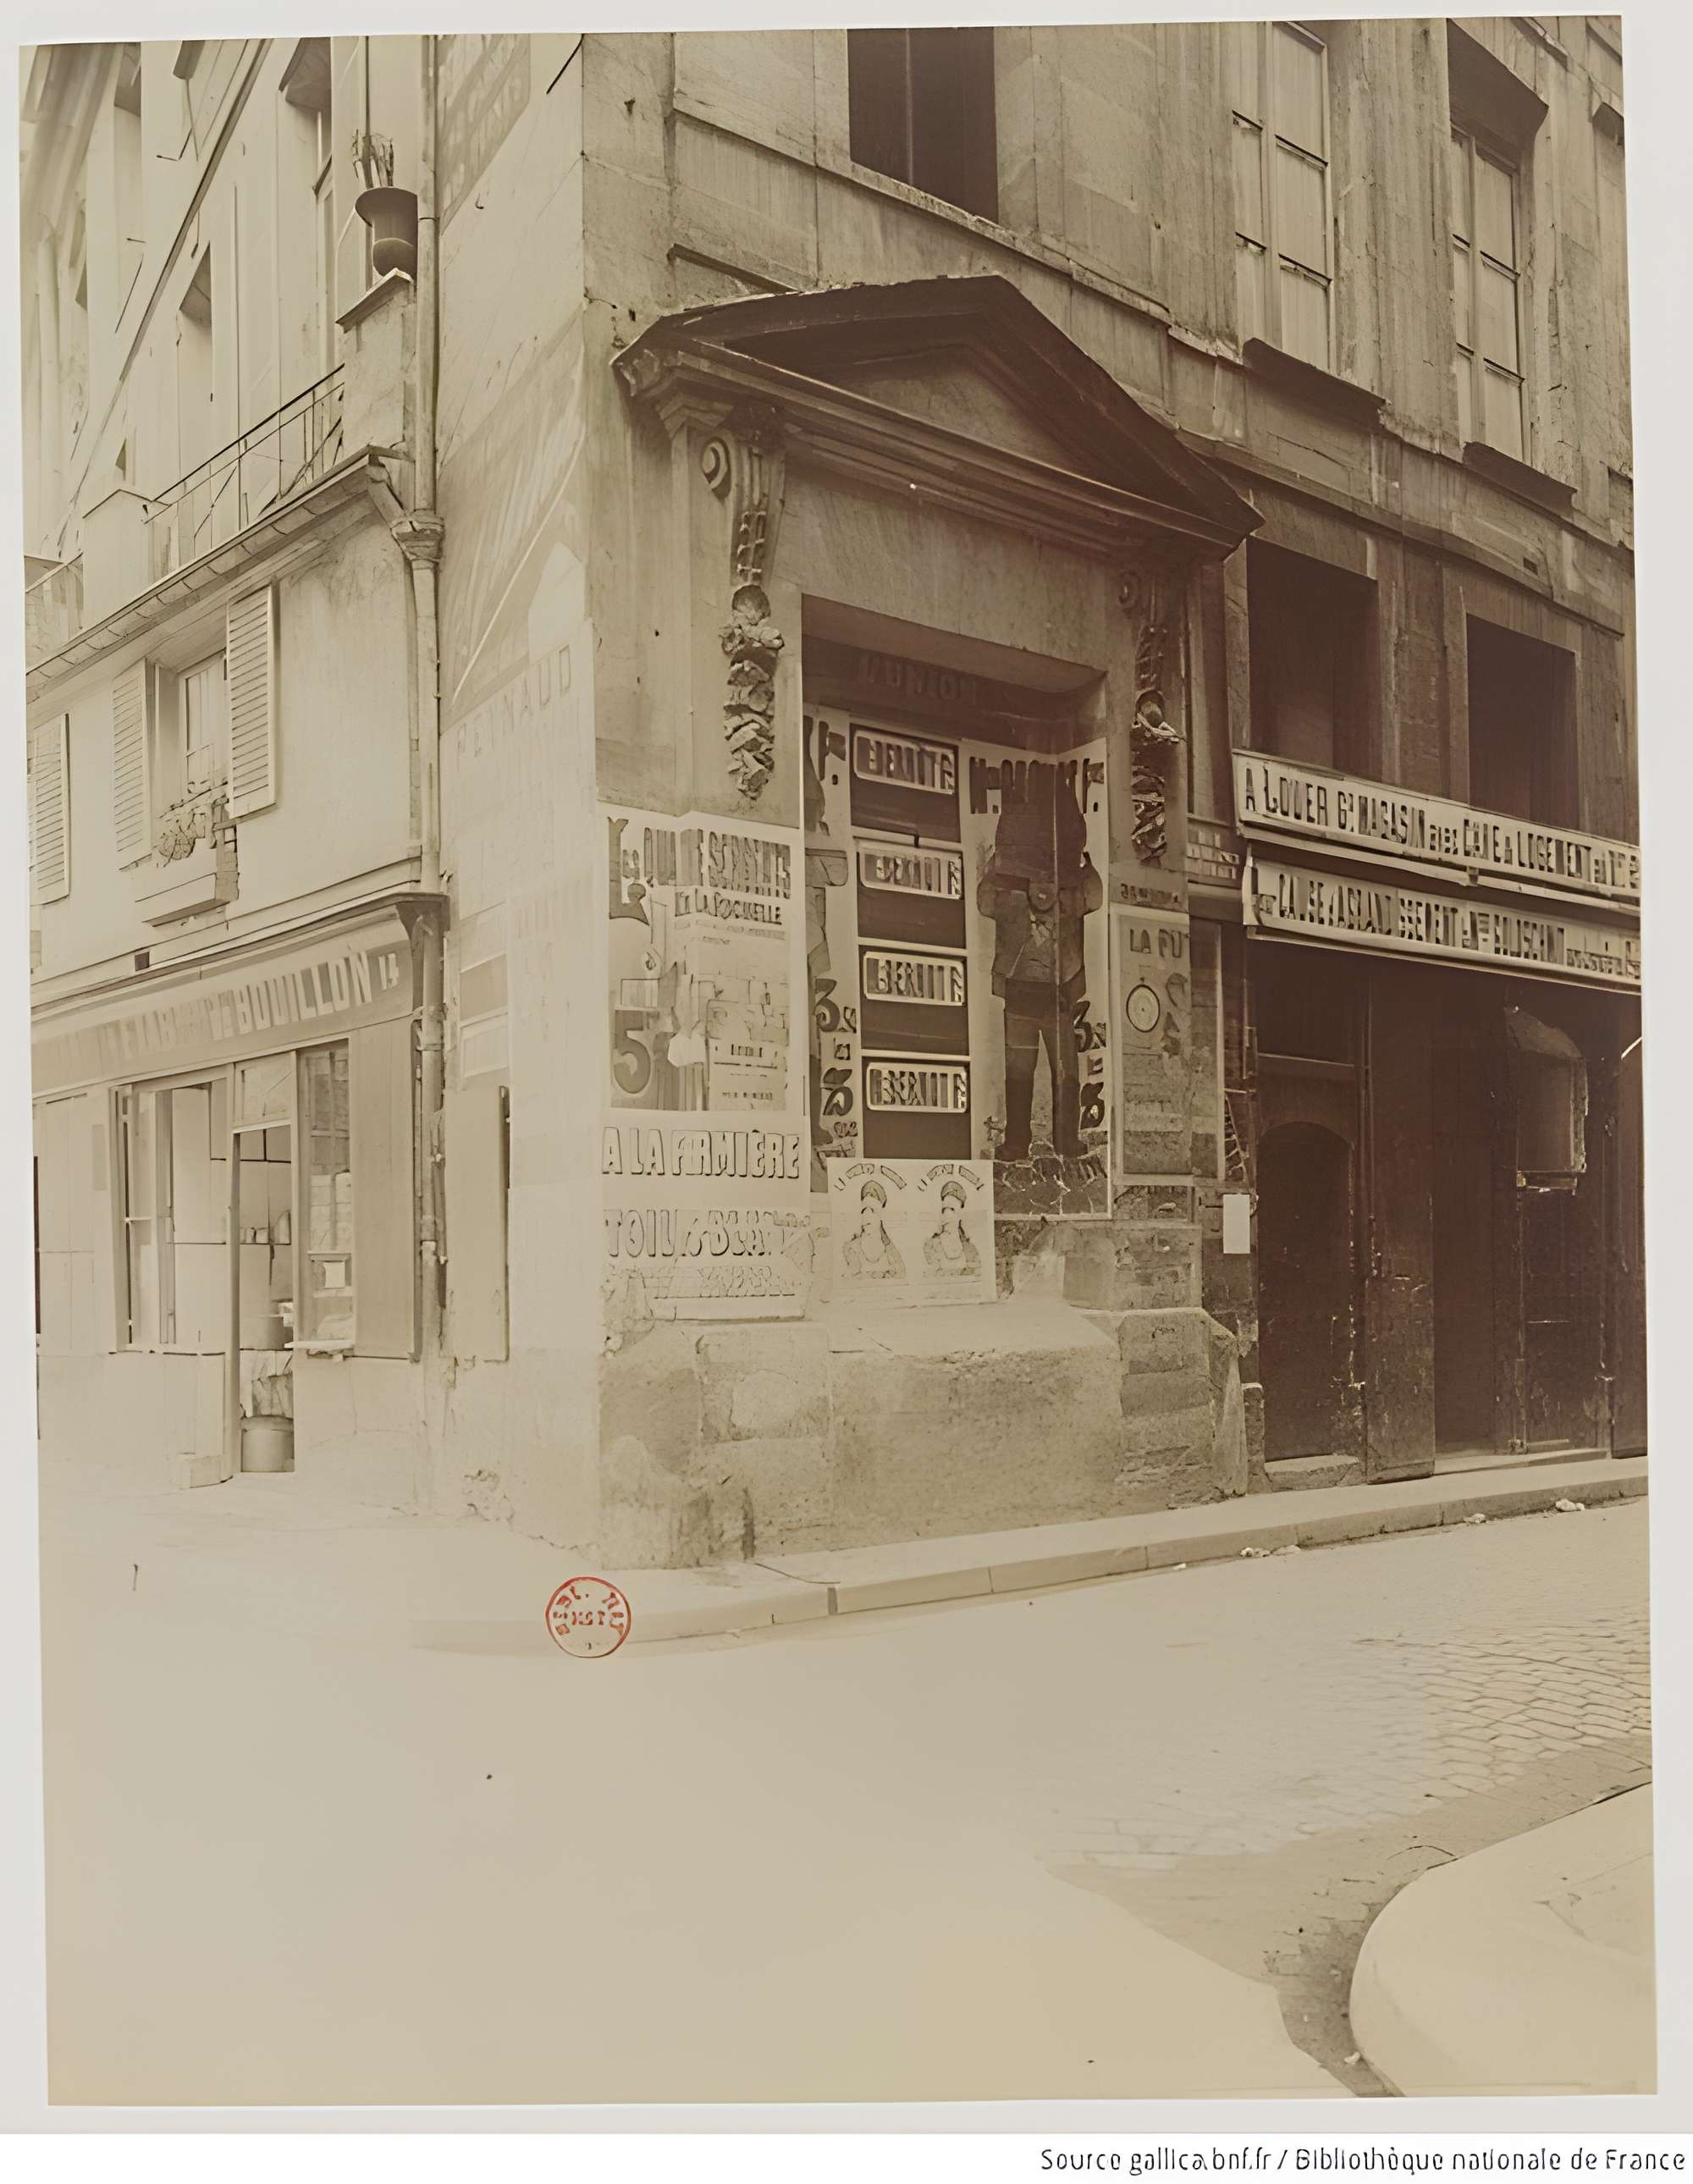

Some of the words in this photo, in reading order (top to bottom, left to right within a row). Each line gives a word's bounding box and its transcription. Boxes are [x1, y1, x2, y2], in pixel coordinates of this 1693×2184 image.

[1245, 767, 1256, 813] A
[235, 951, 372, 1038] BOUILLON
[602, 1126, 623, 1176] A
[630, 1128, 665, 1176] LA
